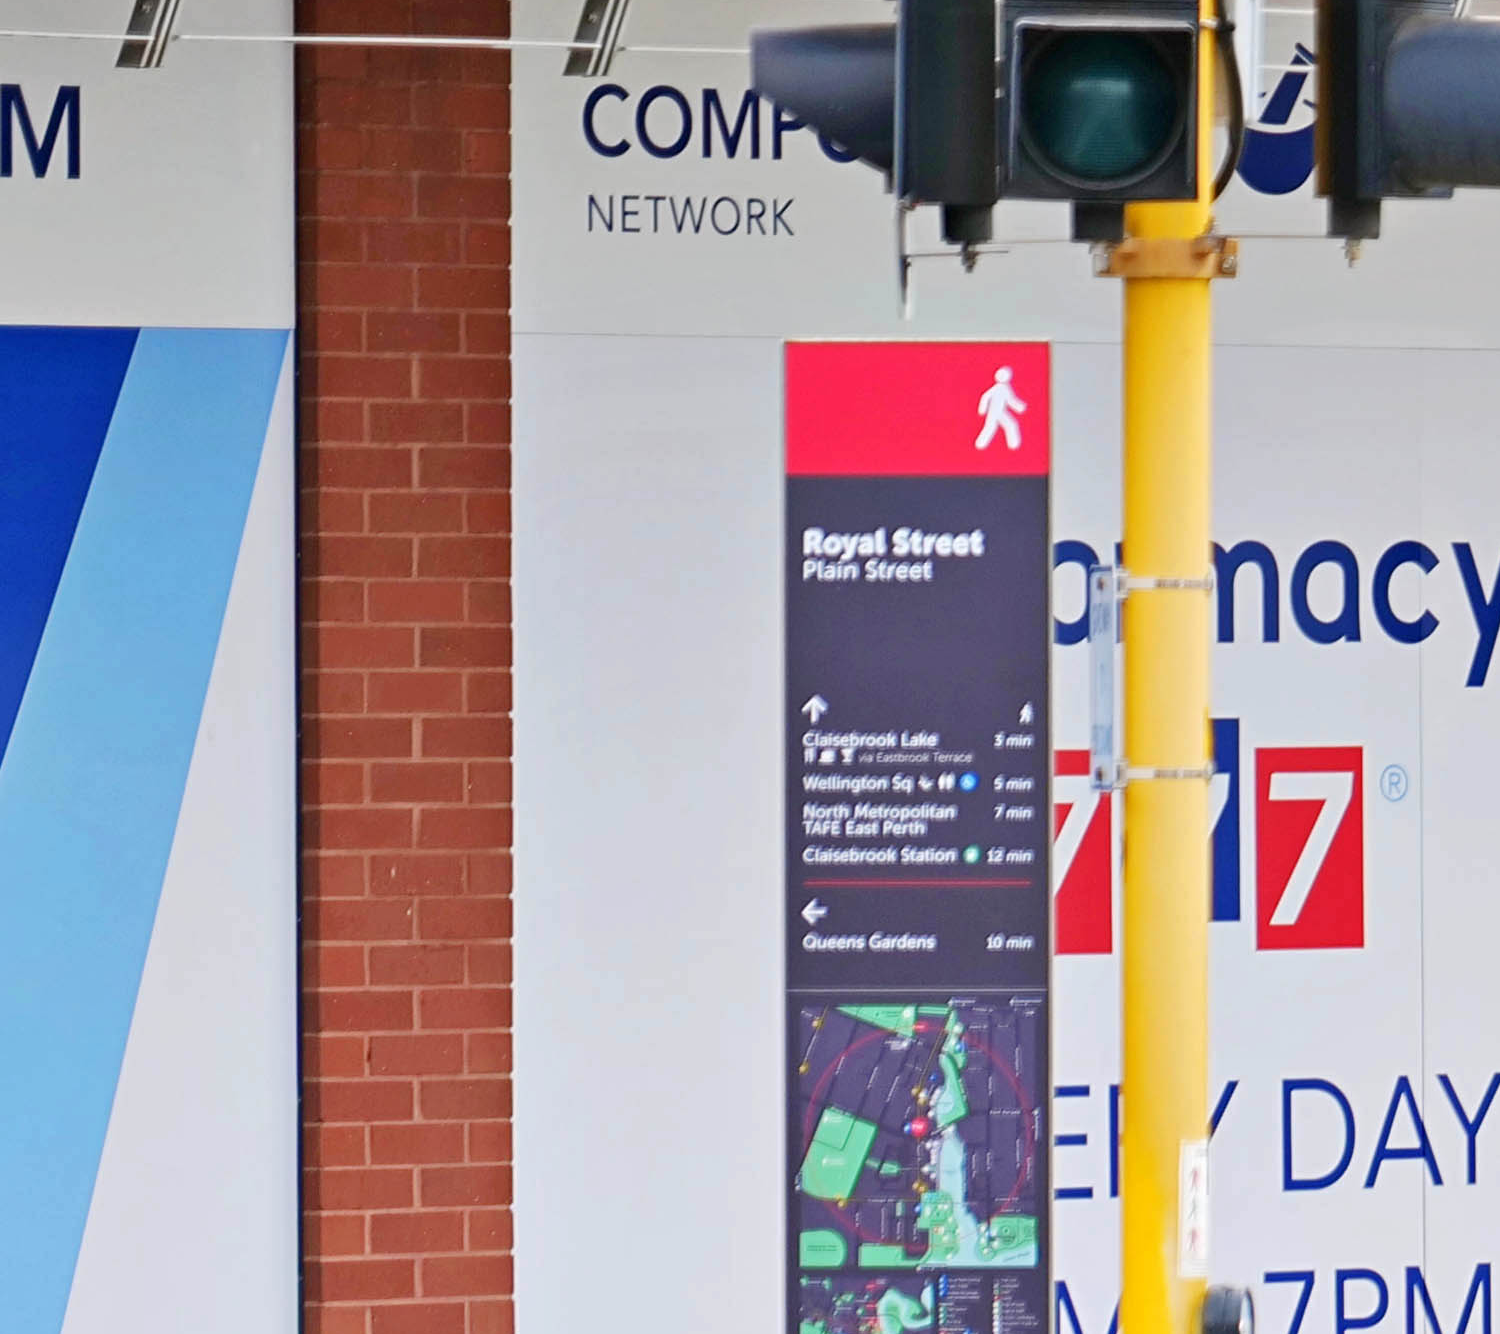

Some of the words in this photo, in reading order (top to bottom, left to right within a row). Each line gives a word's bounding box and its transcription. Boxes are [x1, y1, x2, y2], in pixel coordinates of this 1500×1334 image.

[583, 84, 861, 163] COMP
[588, 194, 795, 236] NETWORK
[802, 527, 887, 561] Royal
[891, 527, 985, 557] Street
[802, 559, 860, 581] Plain
[865, 560, 933, 582] Street
[802, 730, 896, 748] Claisebrook
[900, 730, 939, 748] Lake
[1006, 732, 1033, 748] min
[859, 752, 874, 763] via
[876, 752, 931, 763] Eastbrook
[933, 752, 973, 763] Terrace
[802, 773, 888, 794] Wellington
[891, 773, 913, 794] Sq
[993, 775, 1003, 791] 5
[1006, 775, 1033, 791] min
[802, 803, 849, 822] North
[854, 803, 958, 822] Metropolitan
[993, 804, 1003, 820] 7
[1006, 804, 1033, 820] min
[802, 820, 840, 837] TAFE
[845, 820, 880, 837] East
[883, 820, 928, 837] Perth
[802, 845, 896, 864] Claisebrook
[900, 845, 957, 864] Station
[986, 847, 1003, 864] 12
[1006, 847, 1033, 864] min
[802, 932, 865, 952] Queens
[868, 932, 937, 952] Gardens
[985, 933, 1003, 951] 10
[1006, 933, 1033, 951] min
